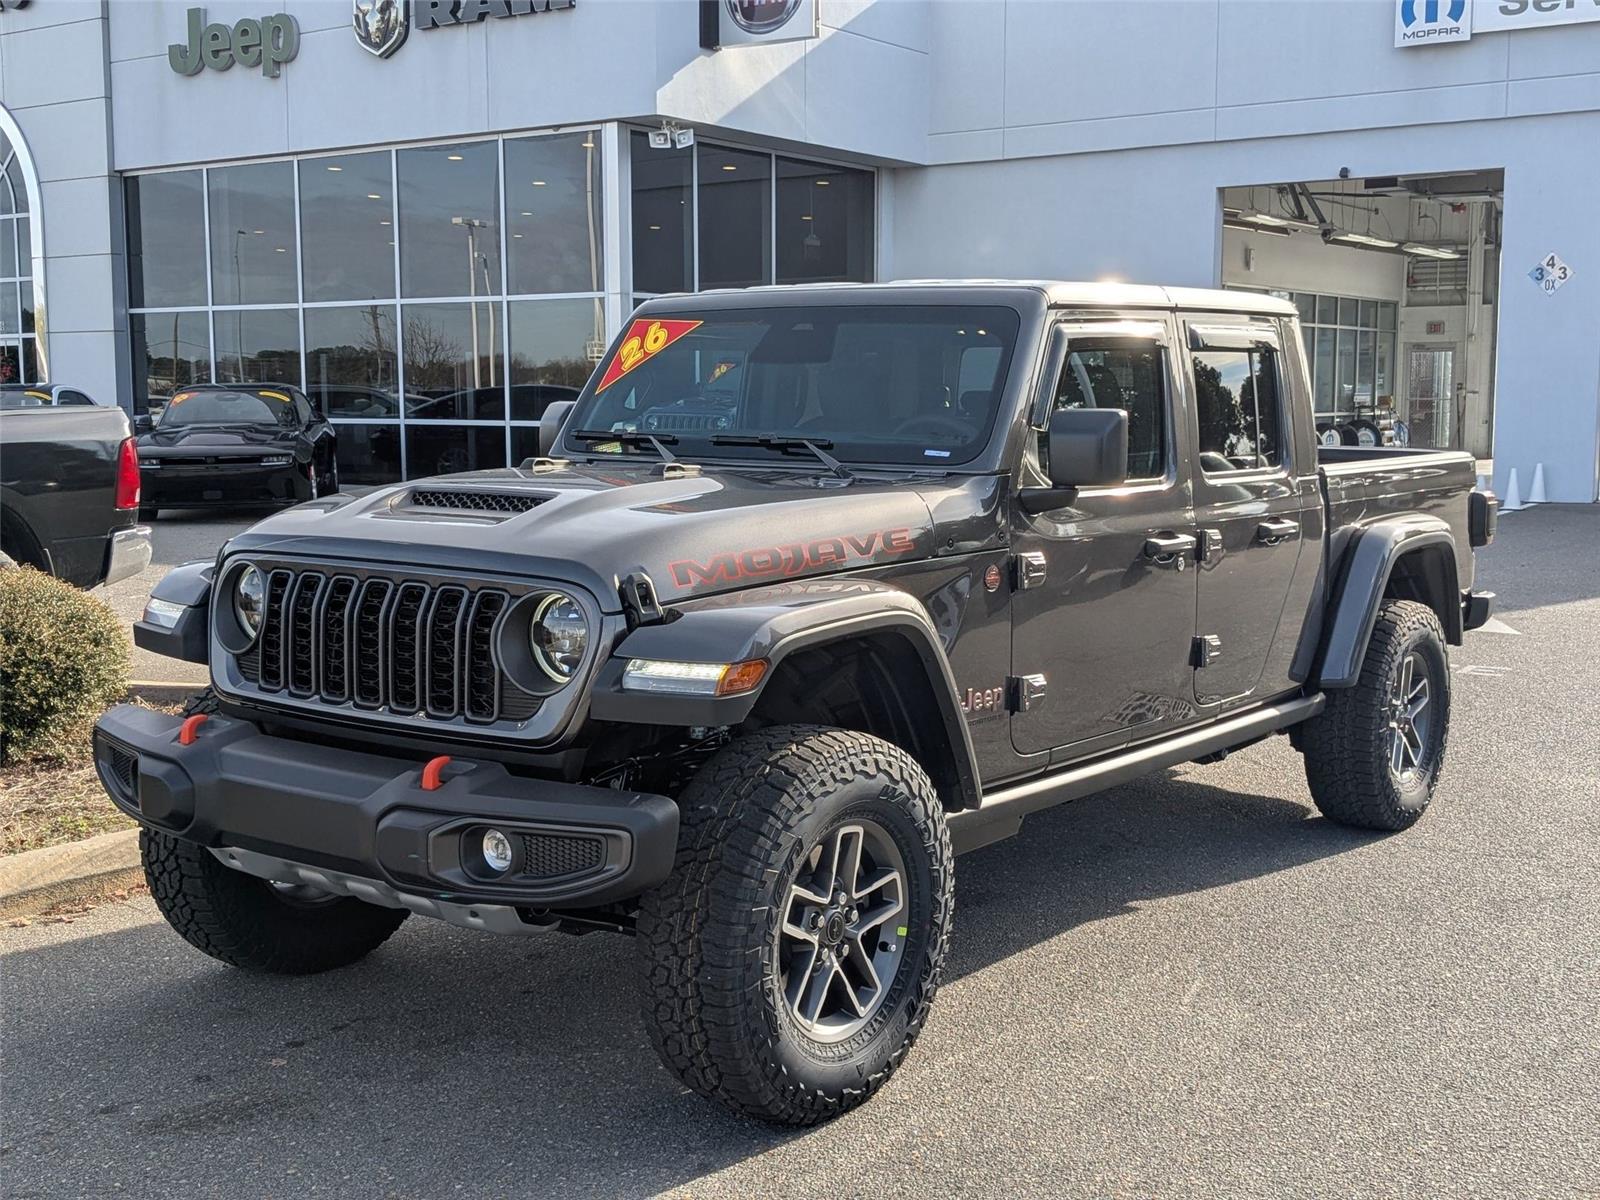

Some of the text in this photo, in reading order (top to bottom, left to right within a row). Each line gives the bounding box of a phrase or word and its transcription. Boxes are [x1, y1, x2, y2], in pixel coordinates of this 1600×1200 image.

[168, 7, 300, 78] Jeep
[1402, 26, 1461, 41] MOPAR
[1535, 266, 1568, 281] 3 3
[1546, 255, 1556, 269] 4
[620, 321, 668, 372] 26
[668, 528, 914, 589] MOJAVE
[960, 687, 1002, 714] Jeep
